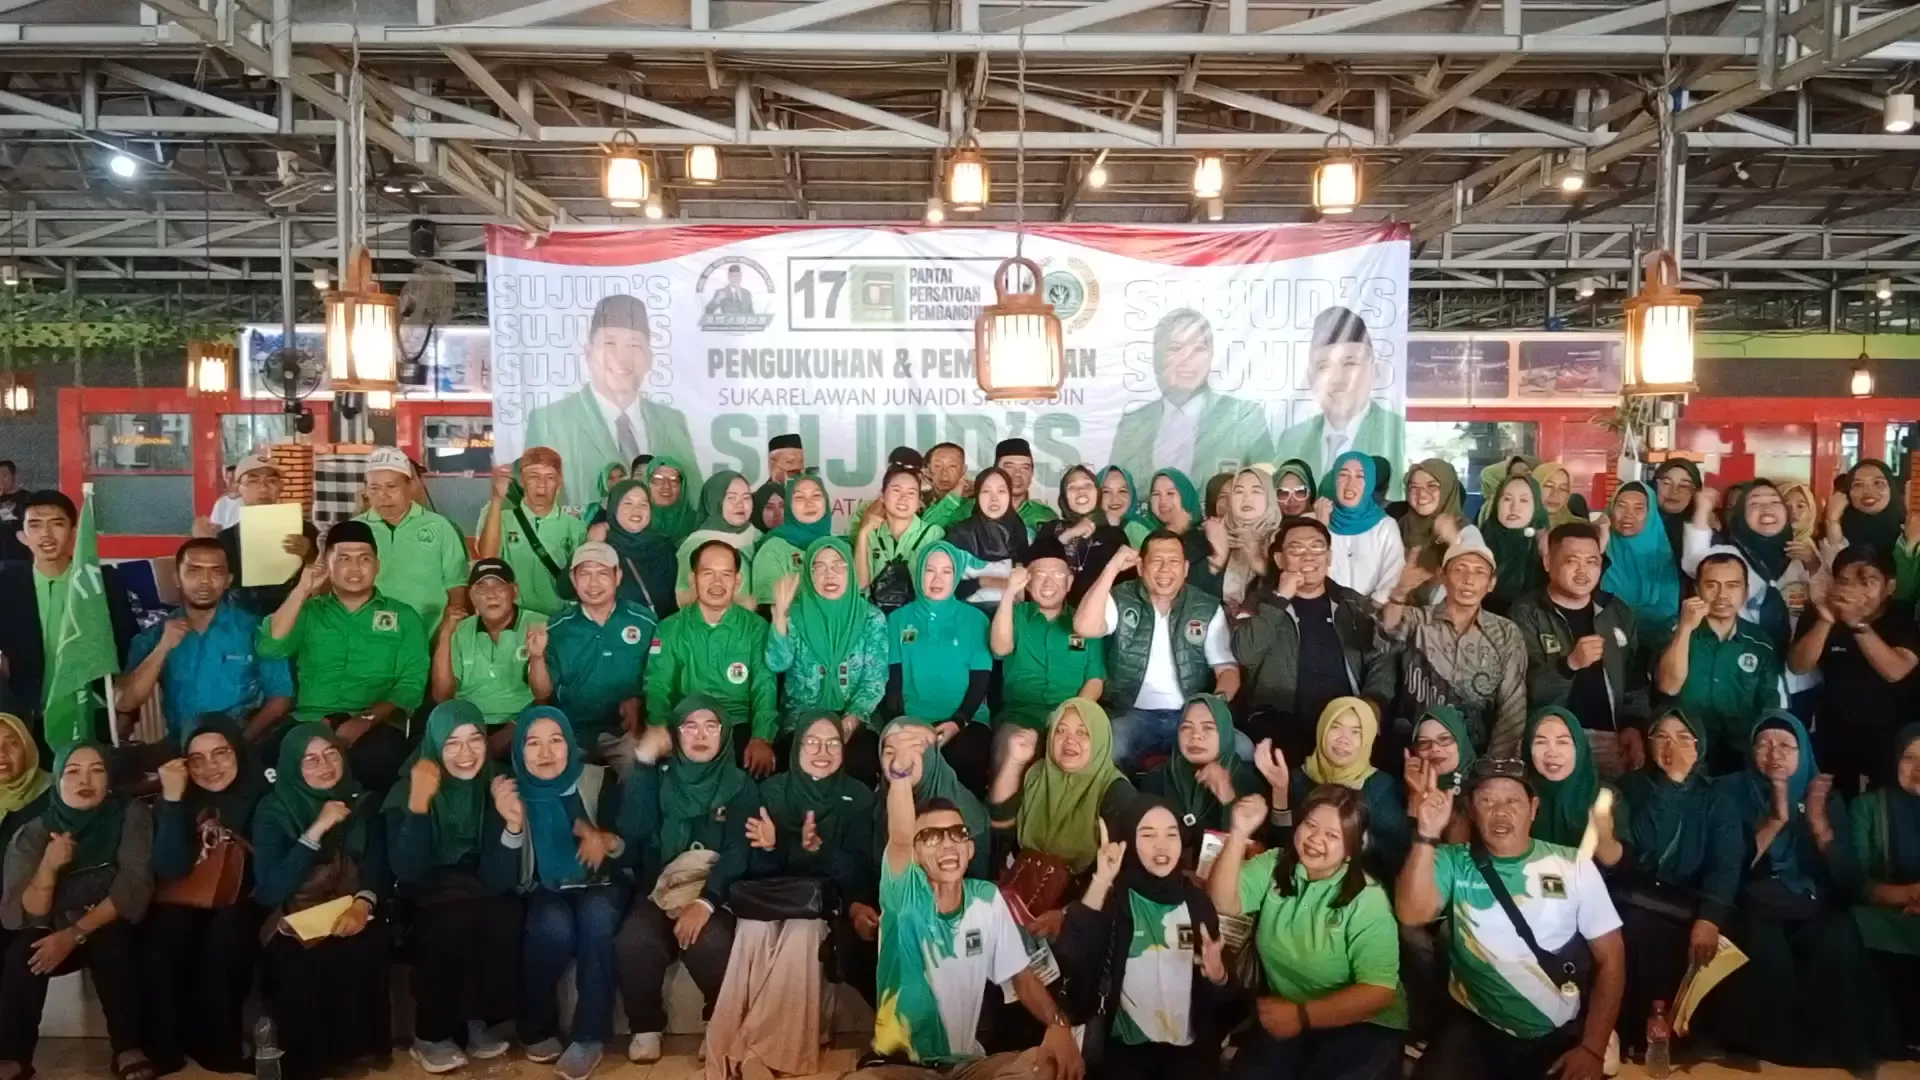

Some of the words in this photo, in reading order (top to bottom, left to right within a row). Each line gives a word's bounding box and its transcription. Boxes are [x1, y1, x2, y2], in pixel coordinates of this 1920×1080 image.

[909, 267, 953, 284] PARTAI
[493, 274, 672, 310] SUJUD'S
[794, 269, 847, 319] 17
[909, 286, 981, 303] PERSATUAN
[707, 347, 884, 379] PENGUKUHAN
[893, 347, 913, 379] &
[718, 387, 876, 406] SUKARELAWAN
[882, 387, 965, 406] JUNAIDI
